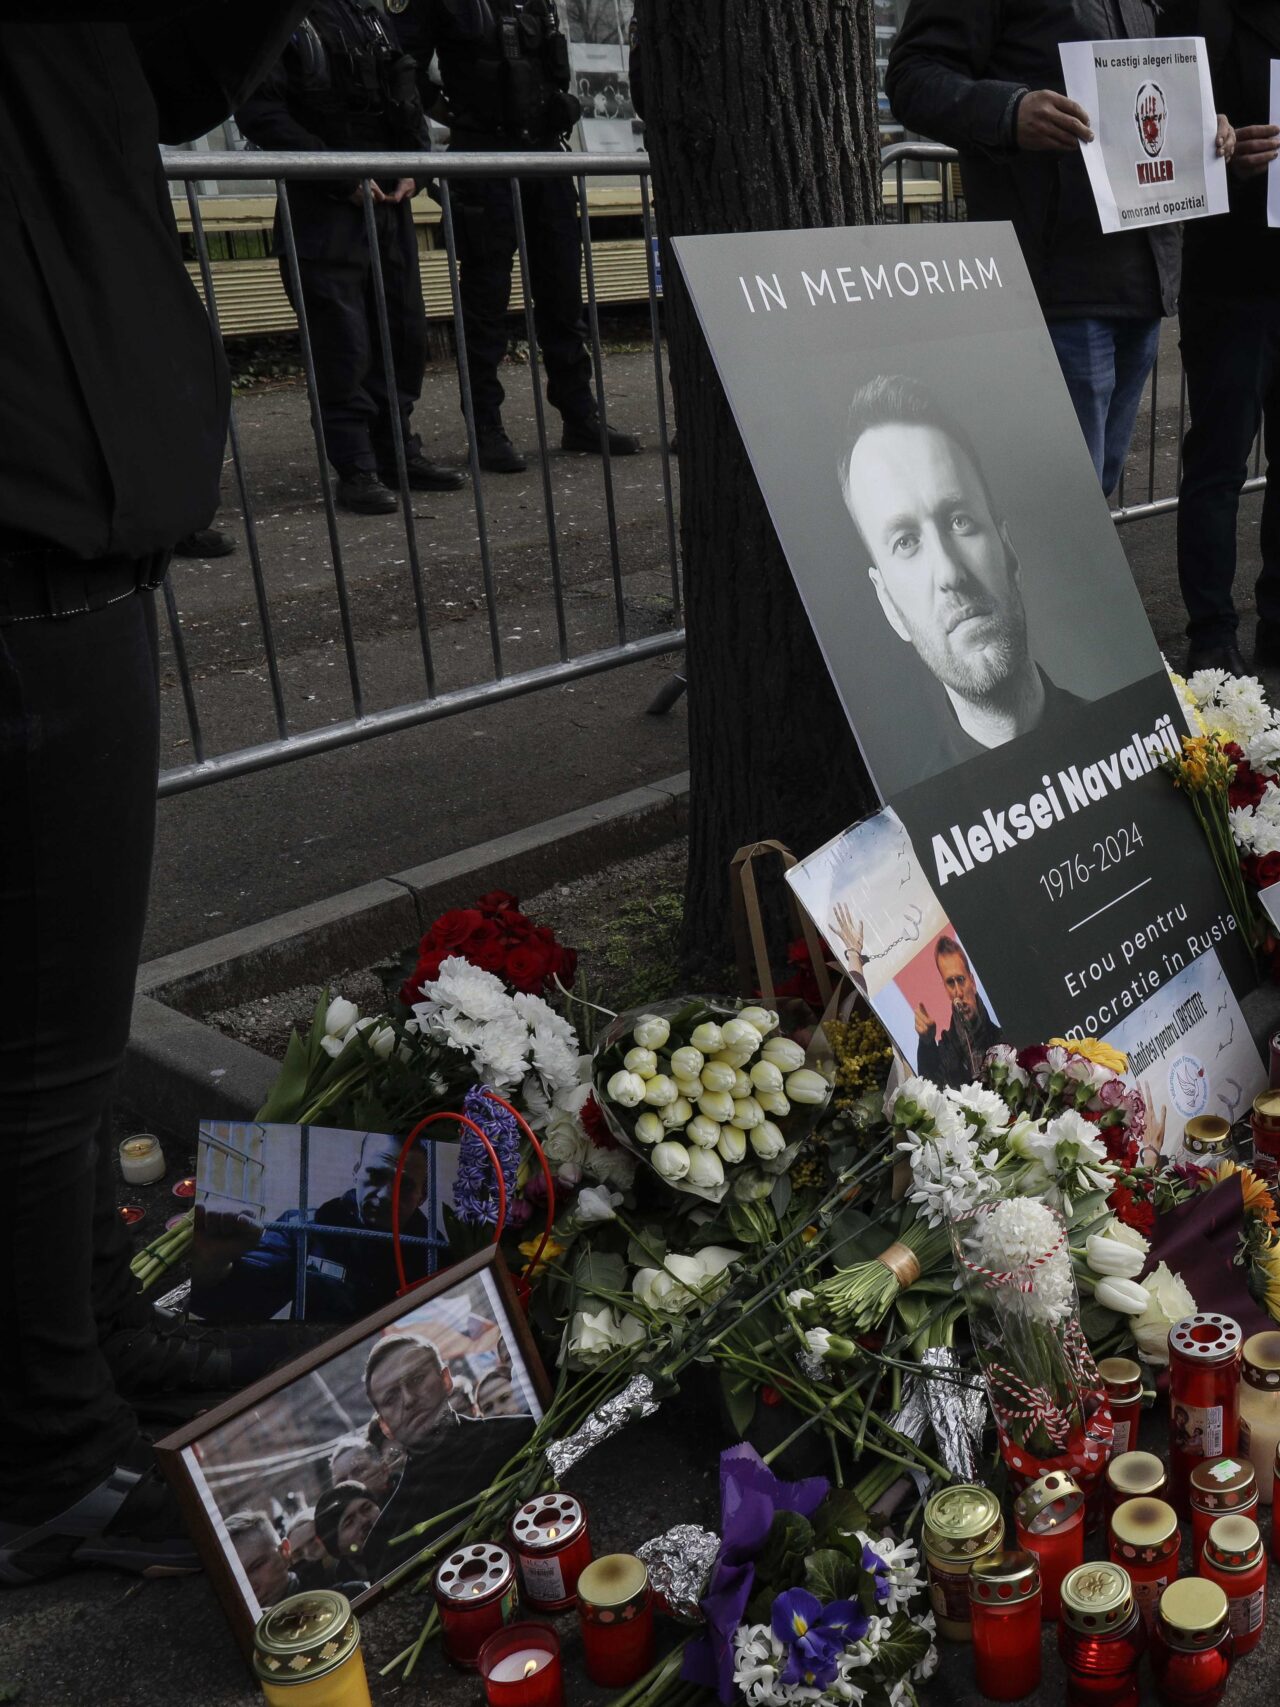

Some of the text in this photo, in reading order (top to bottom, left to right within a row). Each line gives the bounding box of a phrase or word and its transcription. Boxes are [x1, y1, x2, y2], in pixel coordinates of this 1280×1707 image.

[1095, 53, 1197, 69] Nu castigi alegeri libere
[1136, 160, 1174, 185] KILLER
[1121, 195, 1205, 219] omorand opozitia!
[739, 257, 1003, 312] IN MEMORIAM
[931, 775, 1065, 886] Aleksei
[1040, 822, 1144, 901] 1976-2024
[1064, 903, 1188, 998] Erou pentru
[1162, 954, 1185, 976] în
[1186, 914, 1238, 959] Rusia
[1126, 991, 1208, 1079] Manifest pentru LIBERTATE
